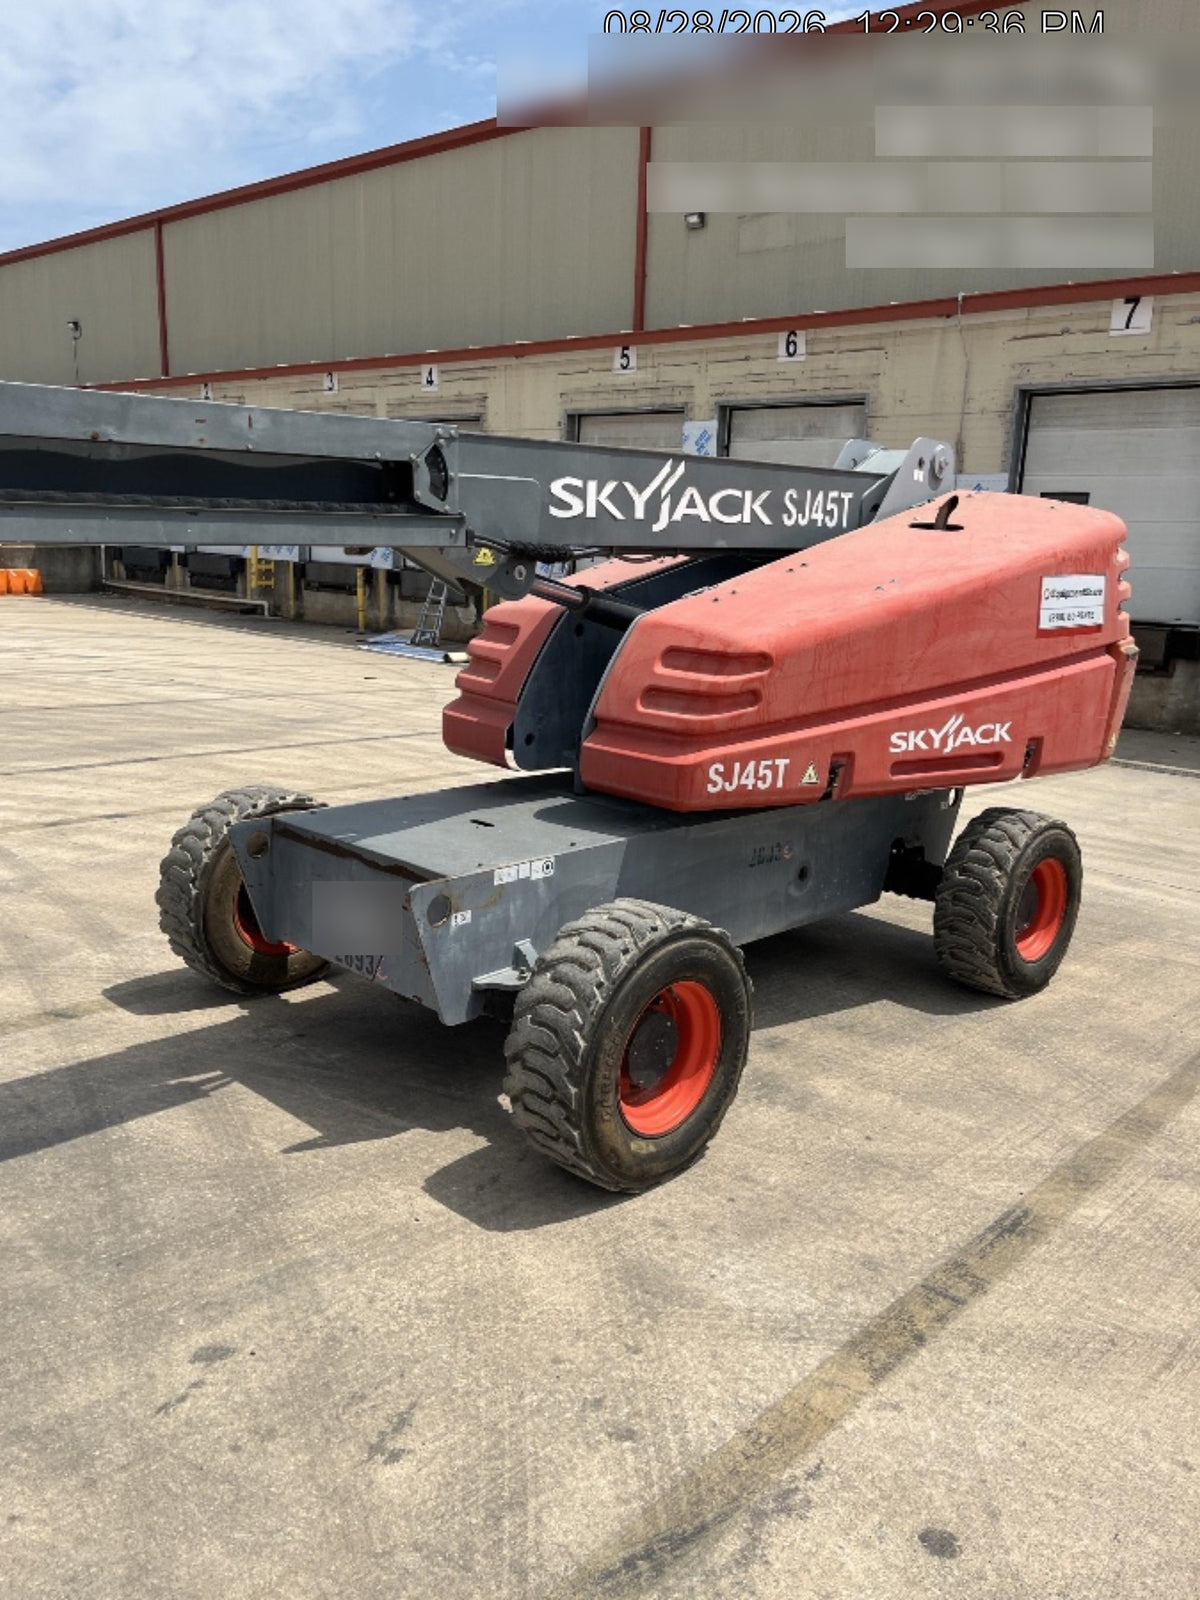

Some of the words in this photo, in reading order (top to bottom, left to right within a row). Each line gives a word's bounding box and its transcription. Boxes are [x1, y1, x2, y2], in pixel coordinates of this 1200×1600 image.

[1124, 296, 1141, 329] 7
[620, 346, 630, 370] 5
[785, 330, 798, 357] 6
[326, 372, 335, 391] 3
[426, 367, 434, 386] 4
[549, 458, 773, 532] SKYJACK
[782, 488, 854, 528] SJ45T
[889, 713, 1013, 754] SKYJACK
[706, 759, 790, 793] SJ45T
